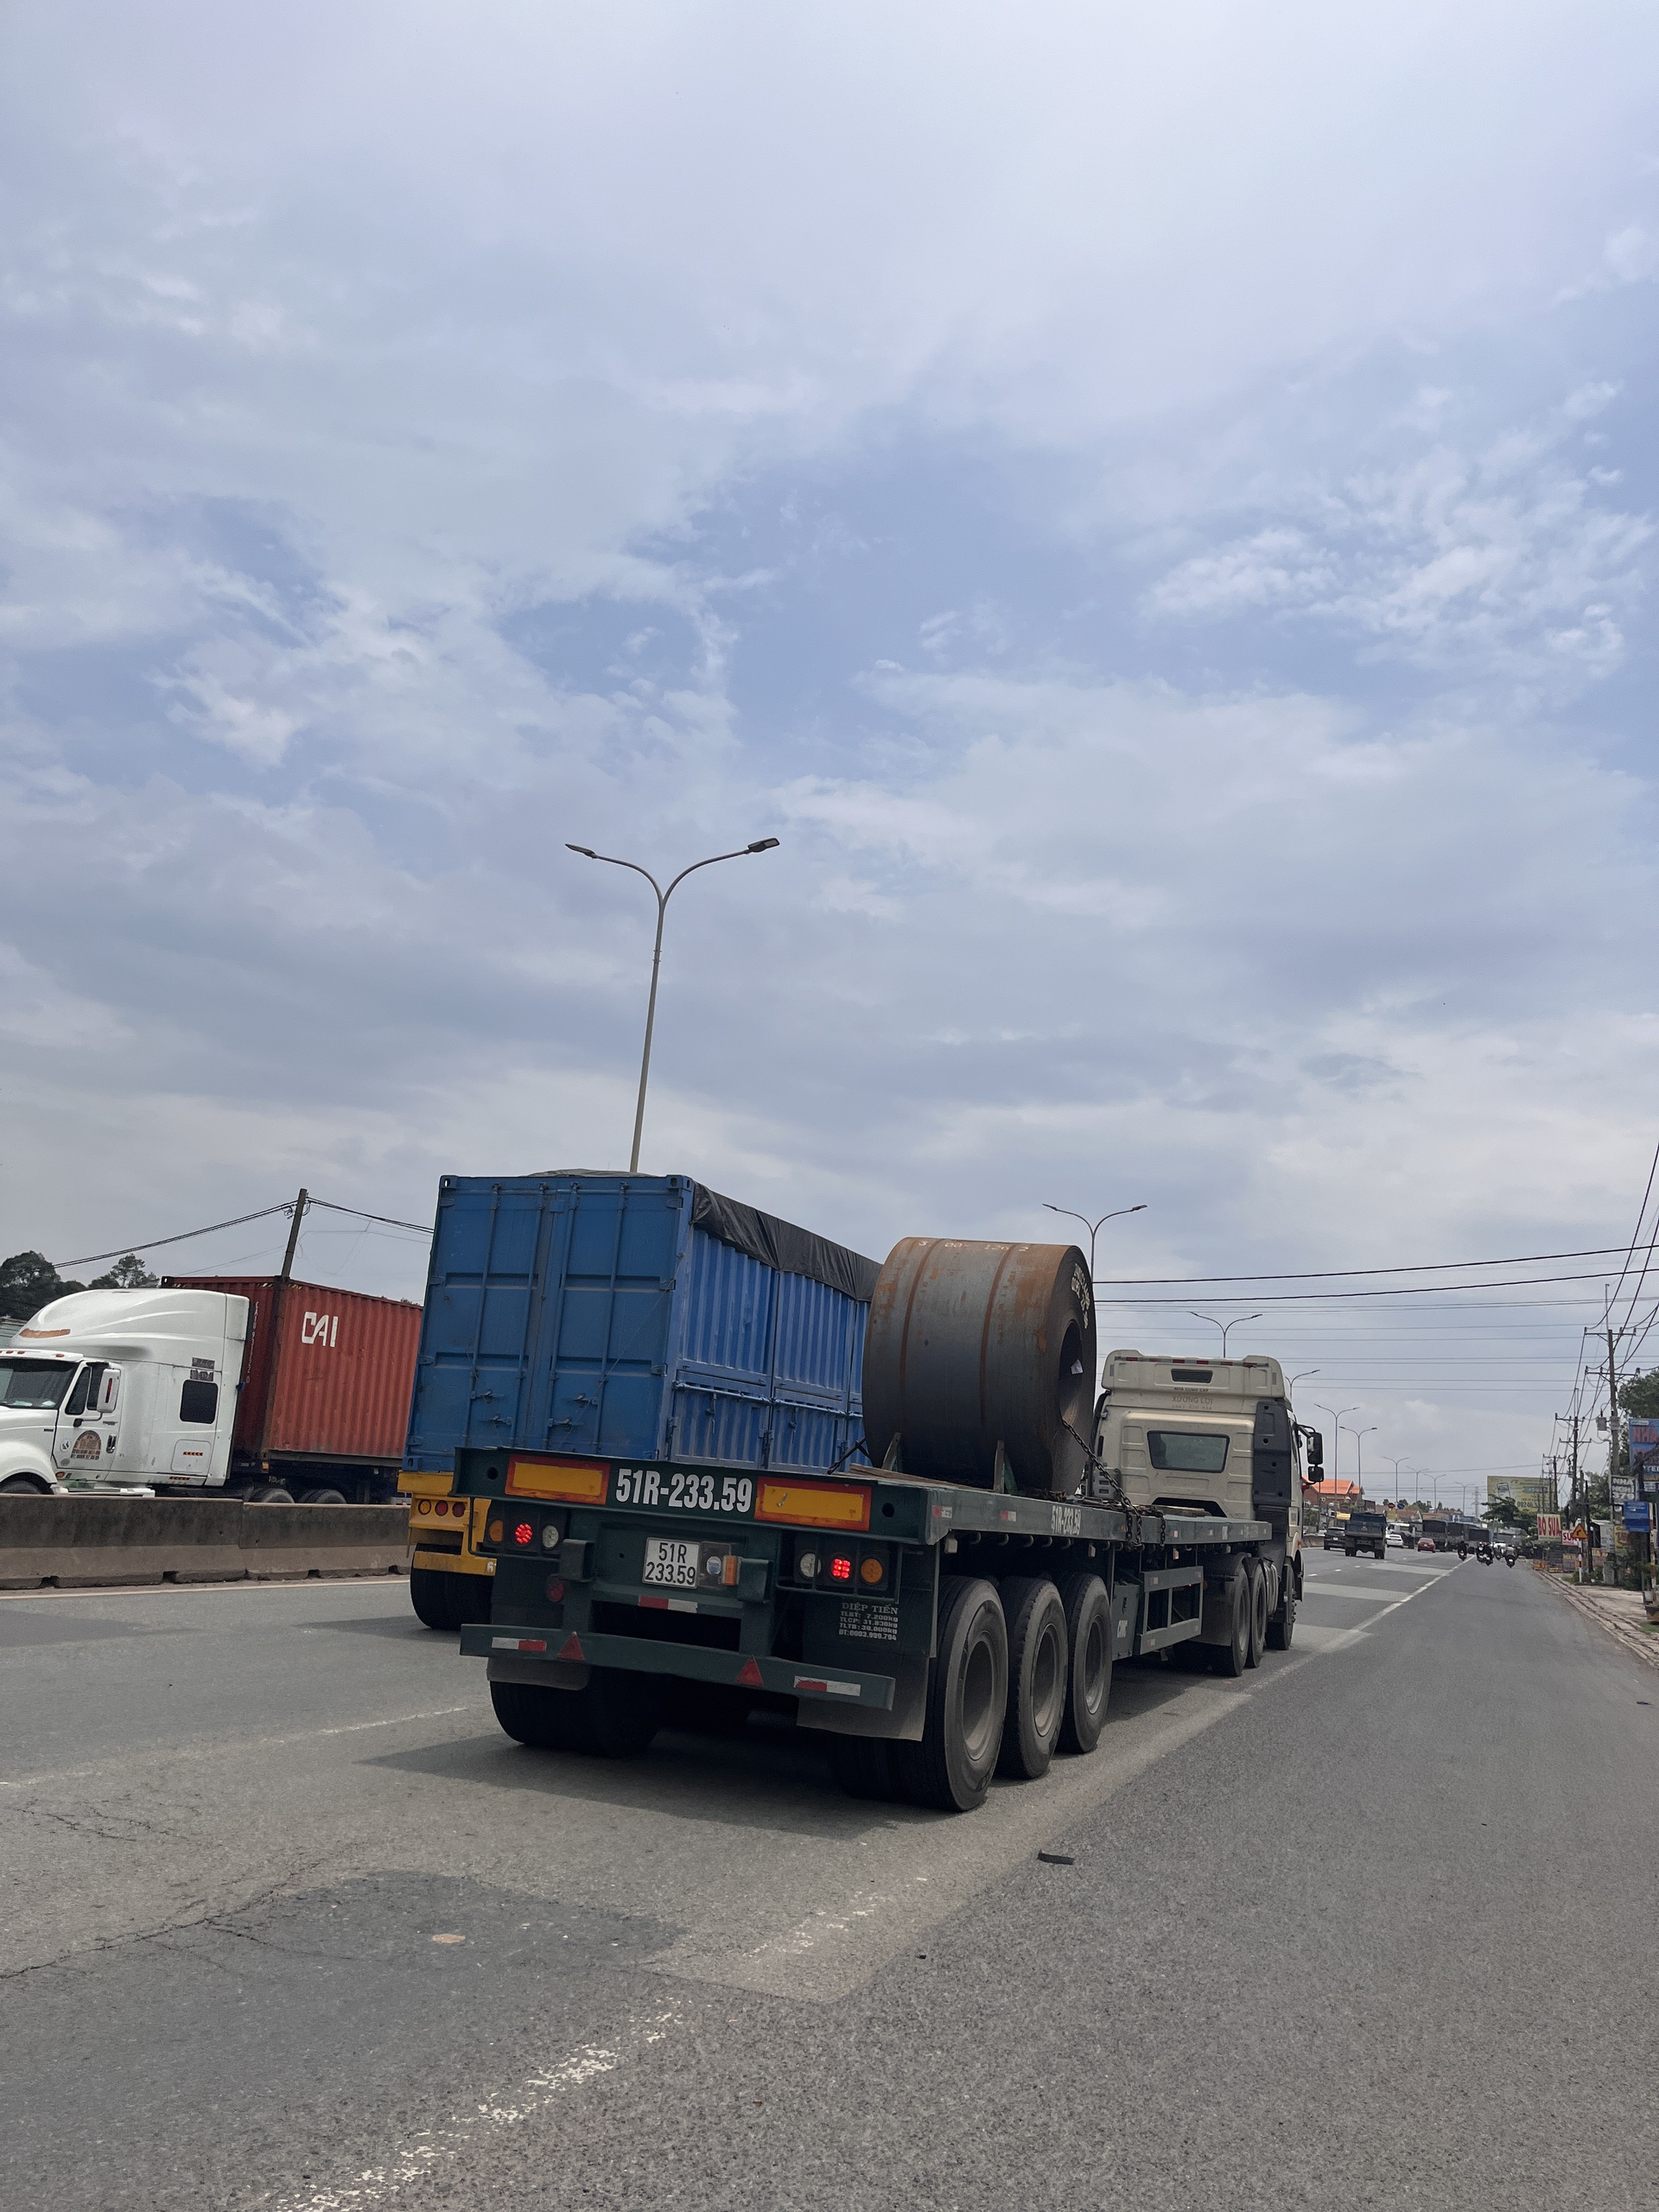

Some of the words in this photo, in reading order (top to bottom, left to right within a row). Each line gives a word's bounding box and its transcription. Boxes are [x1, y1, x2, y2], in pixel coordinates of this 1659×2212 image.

[302, 1311, 338, 1348] CAI
[616, 1468, 753, 1513] 51R-233.59
[658, 1541, 687, 1563] 51R
[645, 1561, 696, 1586] 233.59
